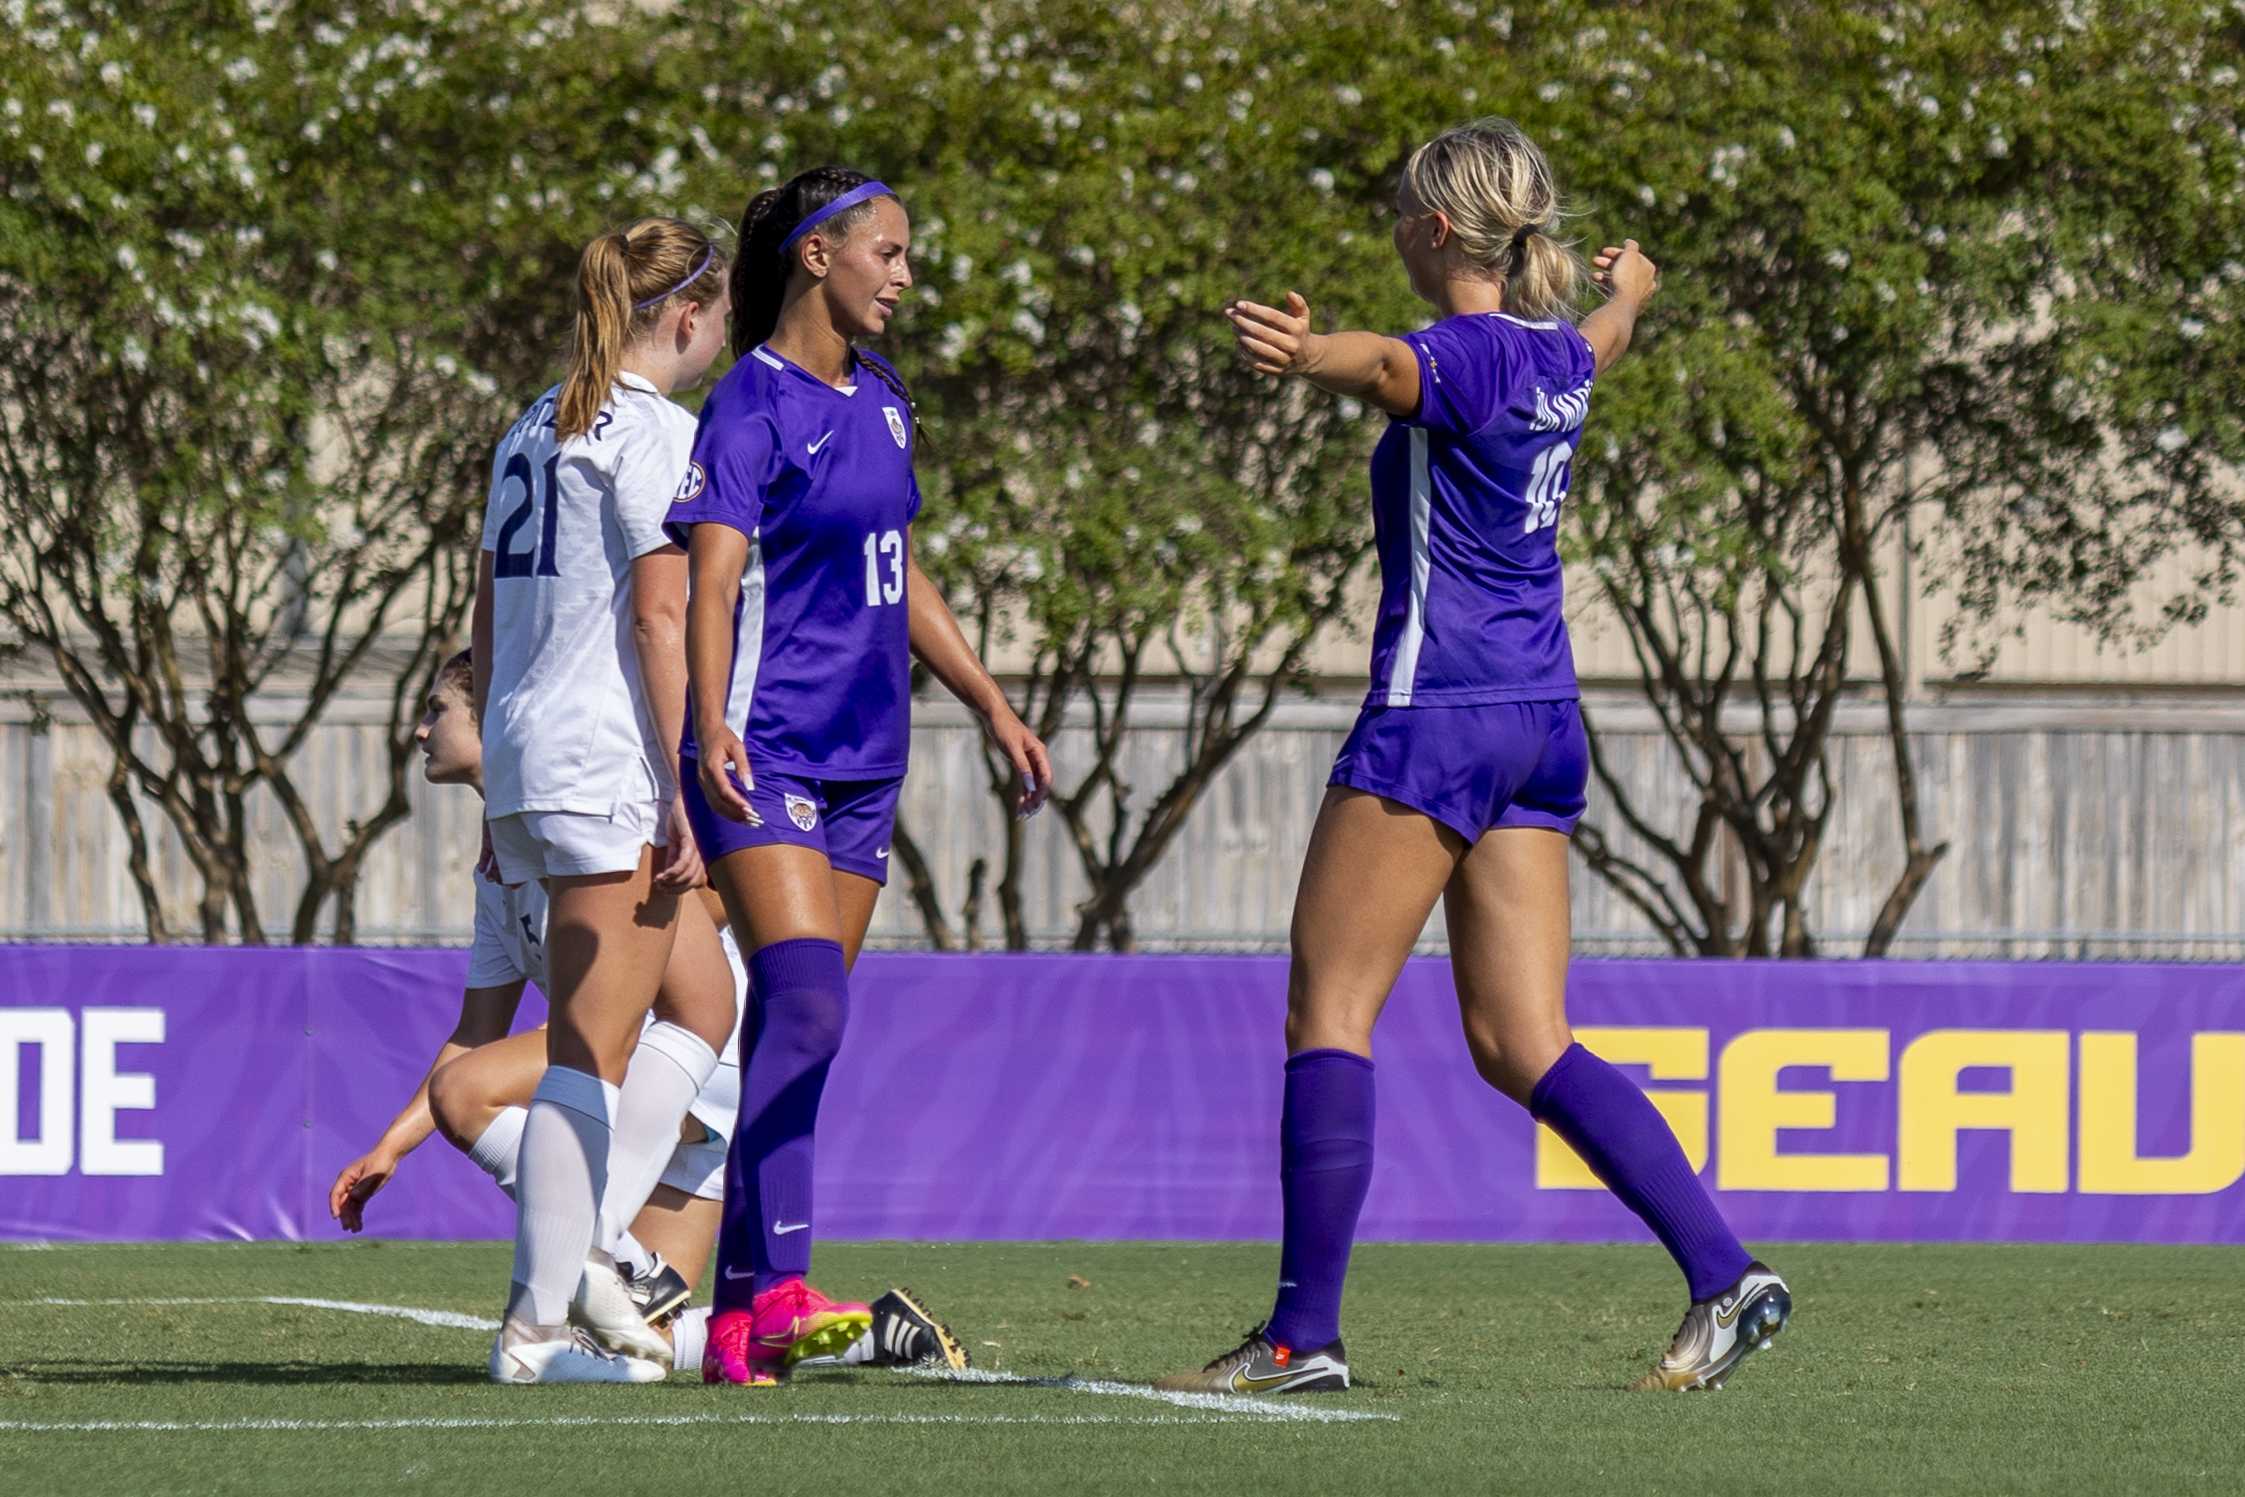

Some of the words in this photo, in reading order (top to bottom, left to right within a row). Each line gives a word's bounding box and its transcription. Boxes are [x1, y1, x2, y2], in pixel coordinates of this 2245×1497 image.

[495, 452, 561, 579] 21
[677, 464, 703, 499] EC
[864, 530, 903, 607] 13
